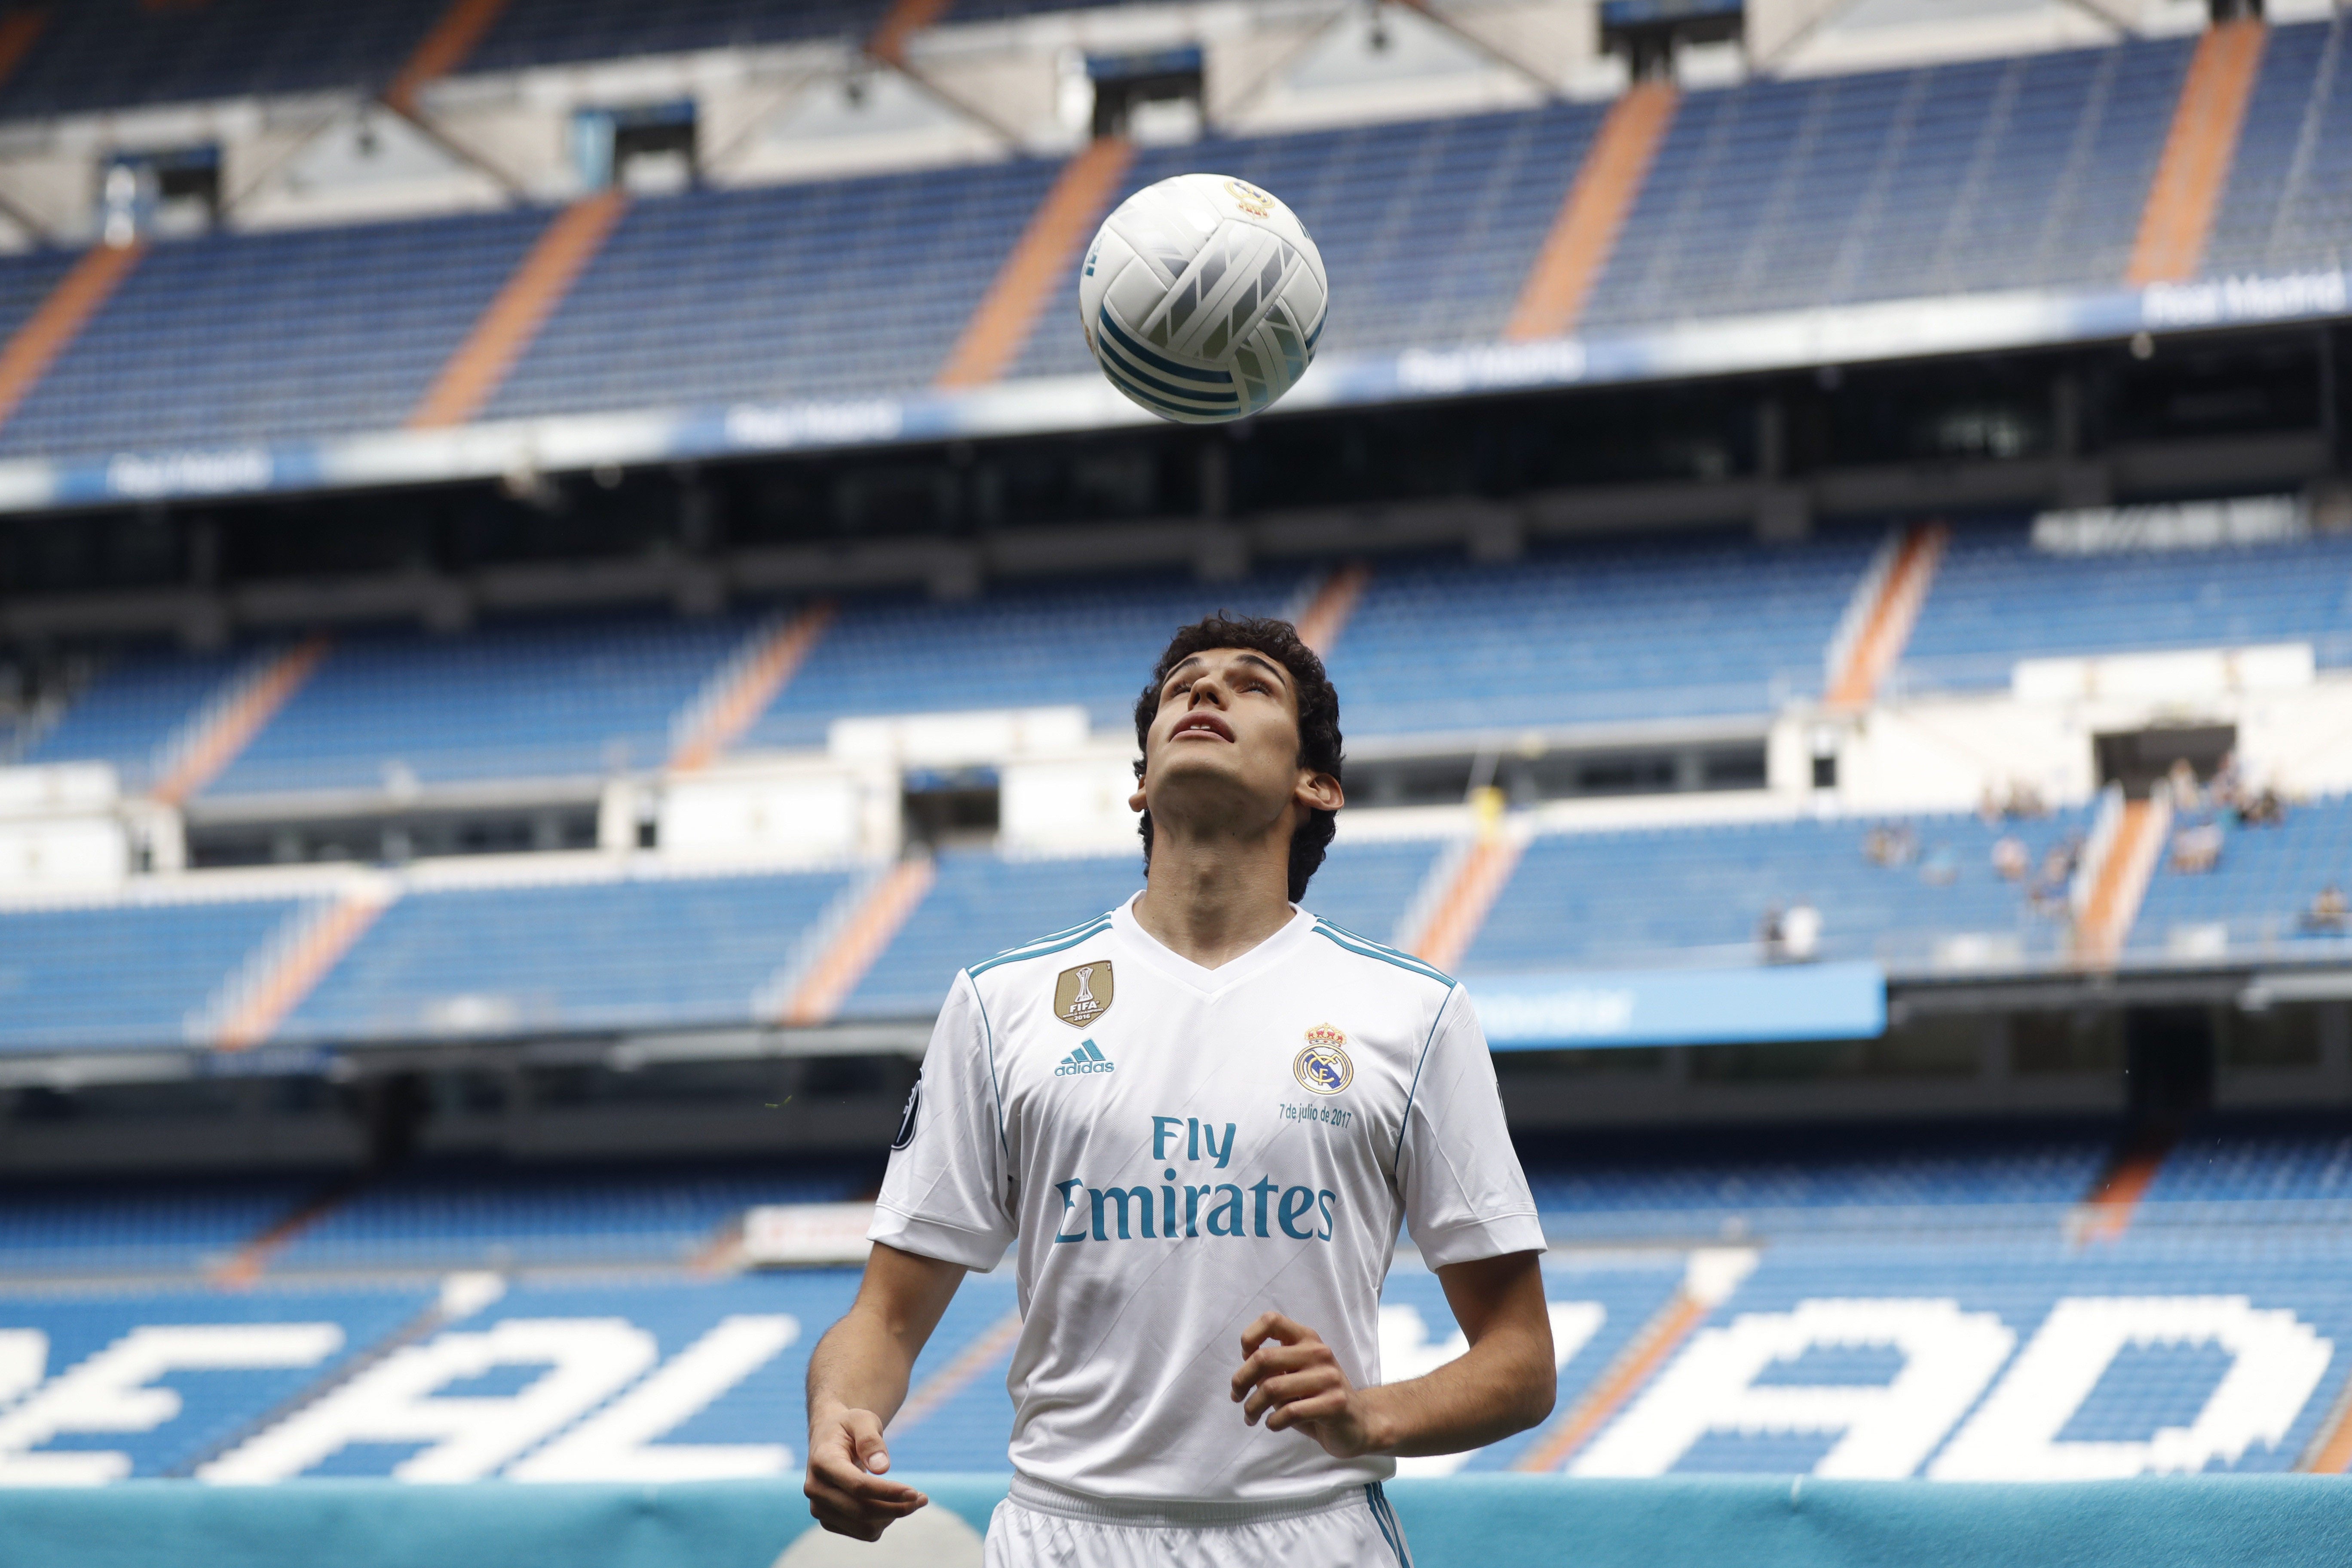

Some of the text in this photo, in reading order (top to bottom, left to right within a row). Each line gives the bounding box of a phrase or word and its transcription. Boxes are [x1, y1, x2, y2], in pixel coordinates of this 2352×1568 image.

[1069, 1001, 1097, 1013] FIFA
[1054, 1061, 1115, 1076] adidas
[1280, 1103, 1351, 1129] 7 de julio de 2017
[1151, 1115, 1236, 1169] Fly
[1054, 1167, 1336, 1243] Emirates
[0, 1314, 800, 1481] EAL
